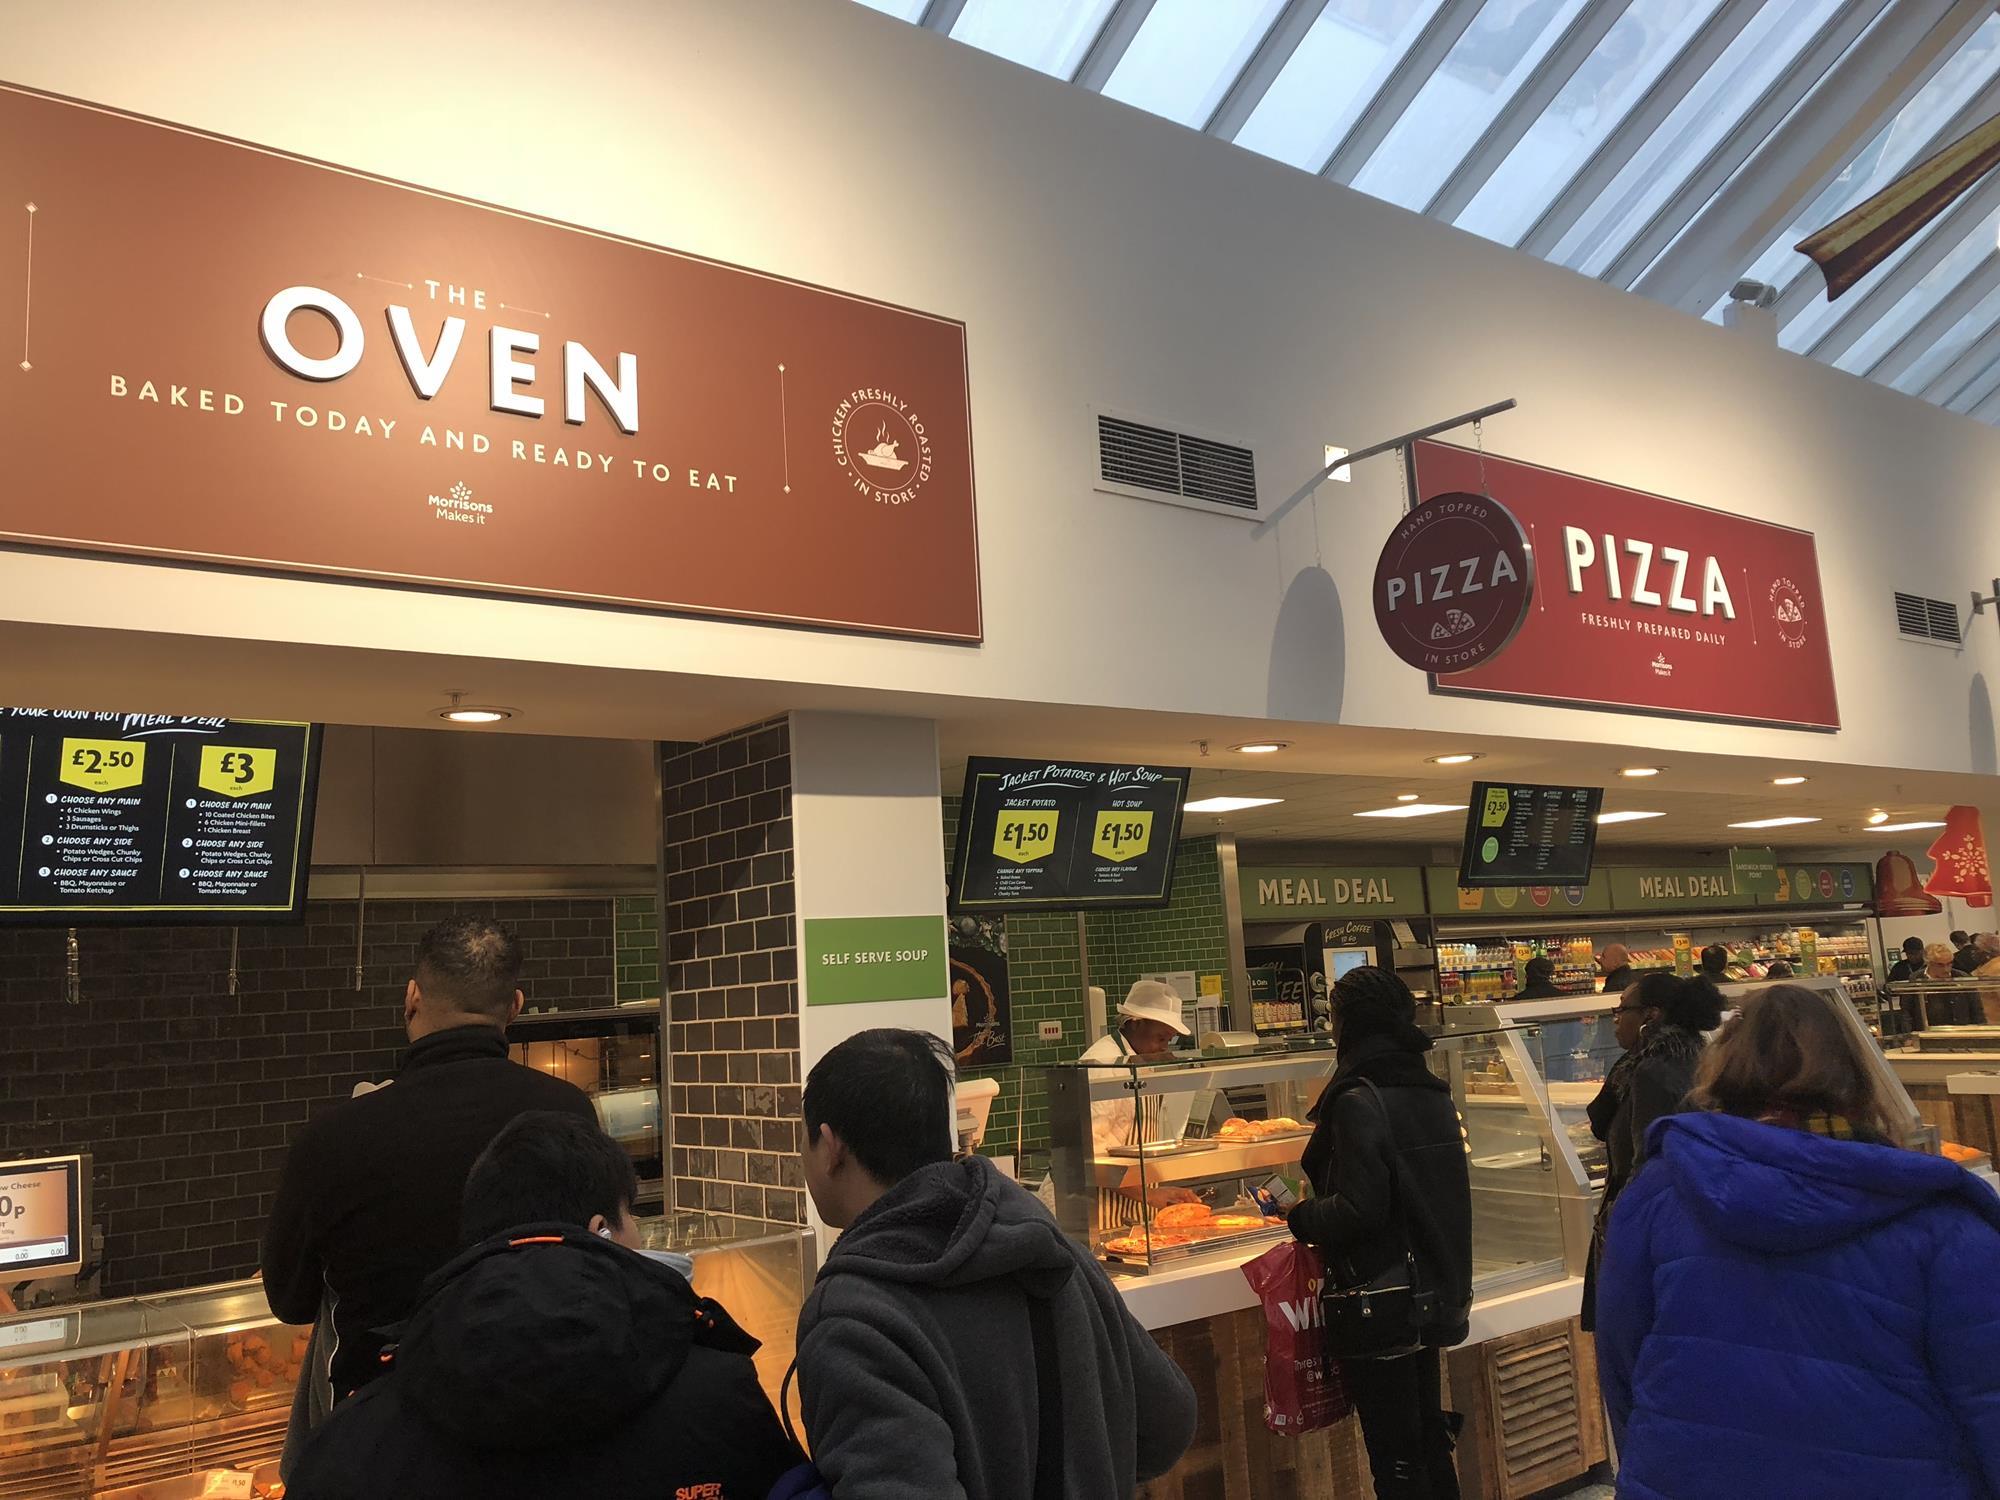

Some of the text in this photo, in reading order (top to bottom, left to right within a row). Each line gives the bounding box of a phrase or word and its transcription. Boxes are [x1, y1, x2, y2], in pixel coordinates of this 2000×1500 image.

[425, 279, 487, 310] THE
[260, 285, 639, 435] OVEN
[110, 374, 737, 493] BAKED TODAY AND READY TO EAT
[832, 387, 932, 482] CHICKEN FRESHLY ROASTED
[428, 494, 493, 513] Morrisons
[854, 478, 916, 505] IN STORE
[436, 509, 486, 524] Makes it
[1400, 501, 1489, 540] HAND TOPPED
[1386, 550, 1518, 612] PIZZA
[1563, 525, 1736, 620] PIZZA
[1581, 612, 1726, 646] FRESHLY PREPARED DAILY
[1424, 642, 1487, 665] IN STORE
[72, 749, 134, 774] £2.50
[220, 752, 255, 783] £3
[998, 764, 1162, 791] JACKET POTATOES & HOT SOUP
[60, 796, 96, 804] CHOOSE
[97, 797, 116, 806] ANY
[200, 801, 230, 809] CHOOSE
[1004, 798, 1030, 807] JACKET
[1487, 800, 1507, 816] £2.50
[1003, 822, 1049, 850] £1.50
[1101, 822, 1144, 849] £1.50
[1259, 878, 1394, 905] MEAL DEAL
[1639, 876, 1729, 899] MEAL DEAL
[1345, 921, 1372, 933] COFFEE
[822, 949, 928, 965] SELF SERVE SOUP
[676, 1483, 721, 1500] SUPER
